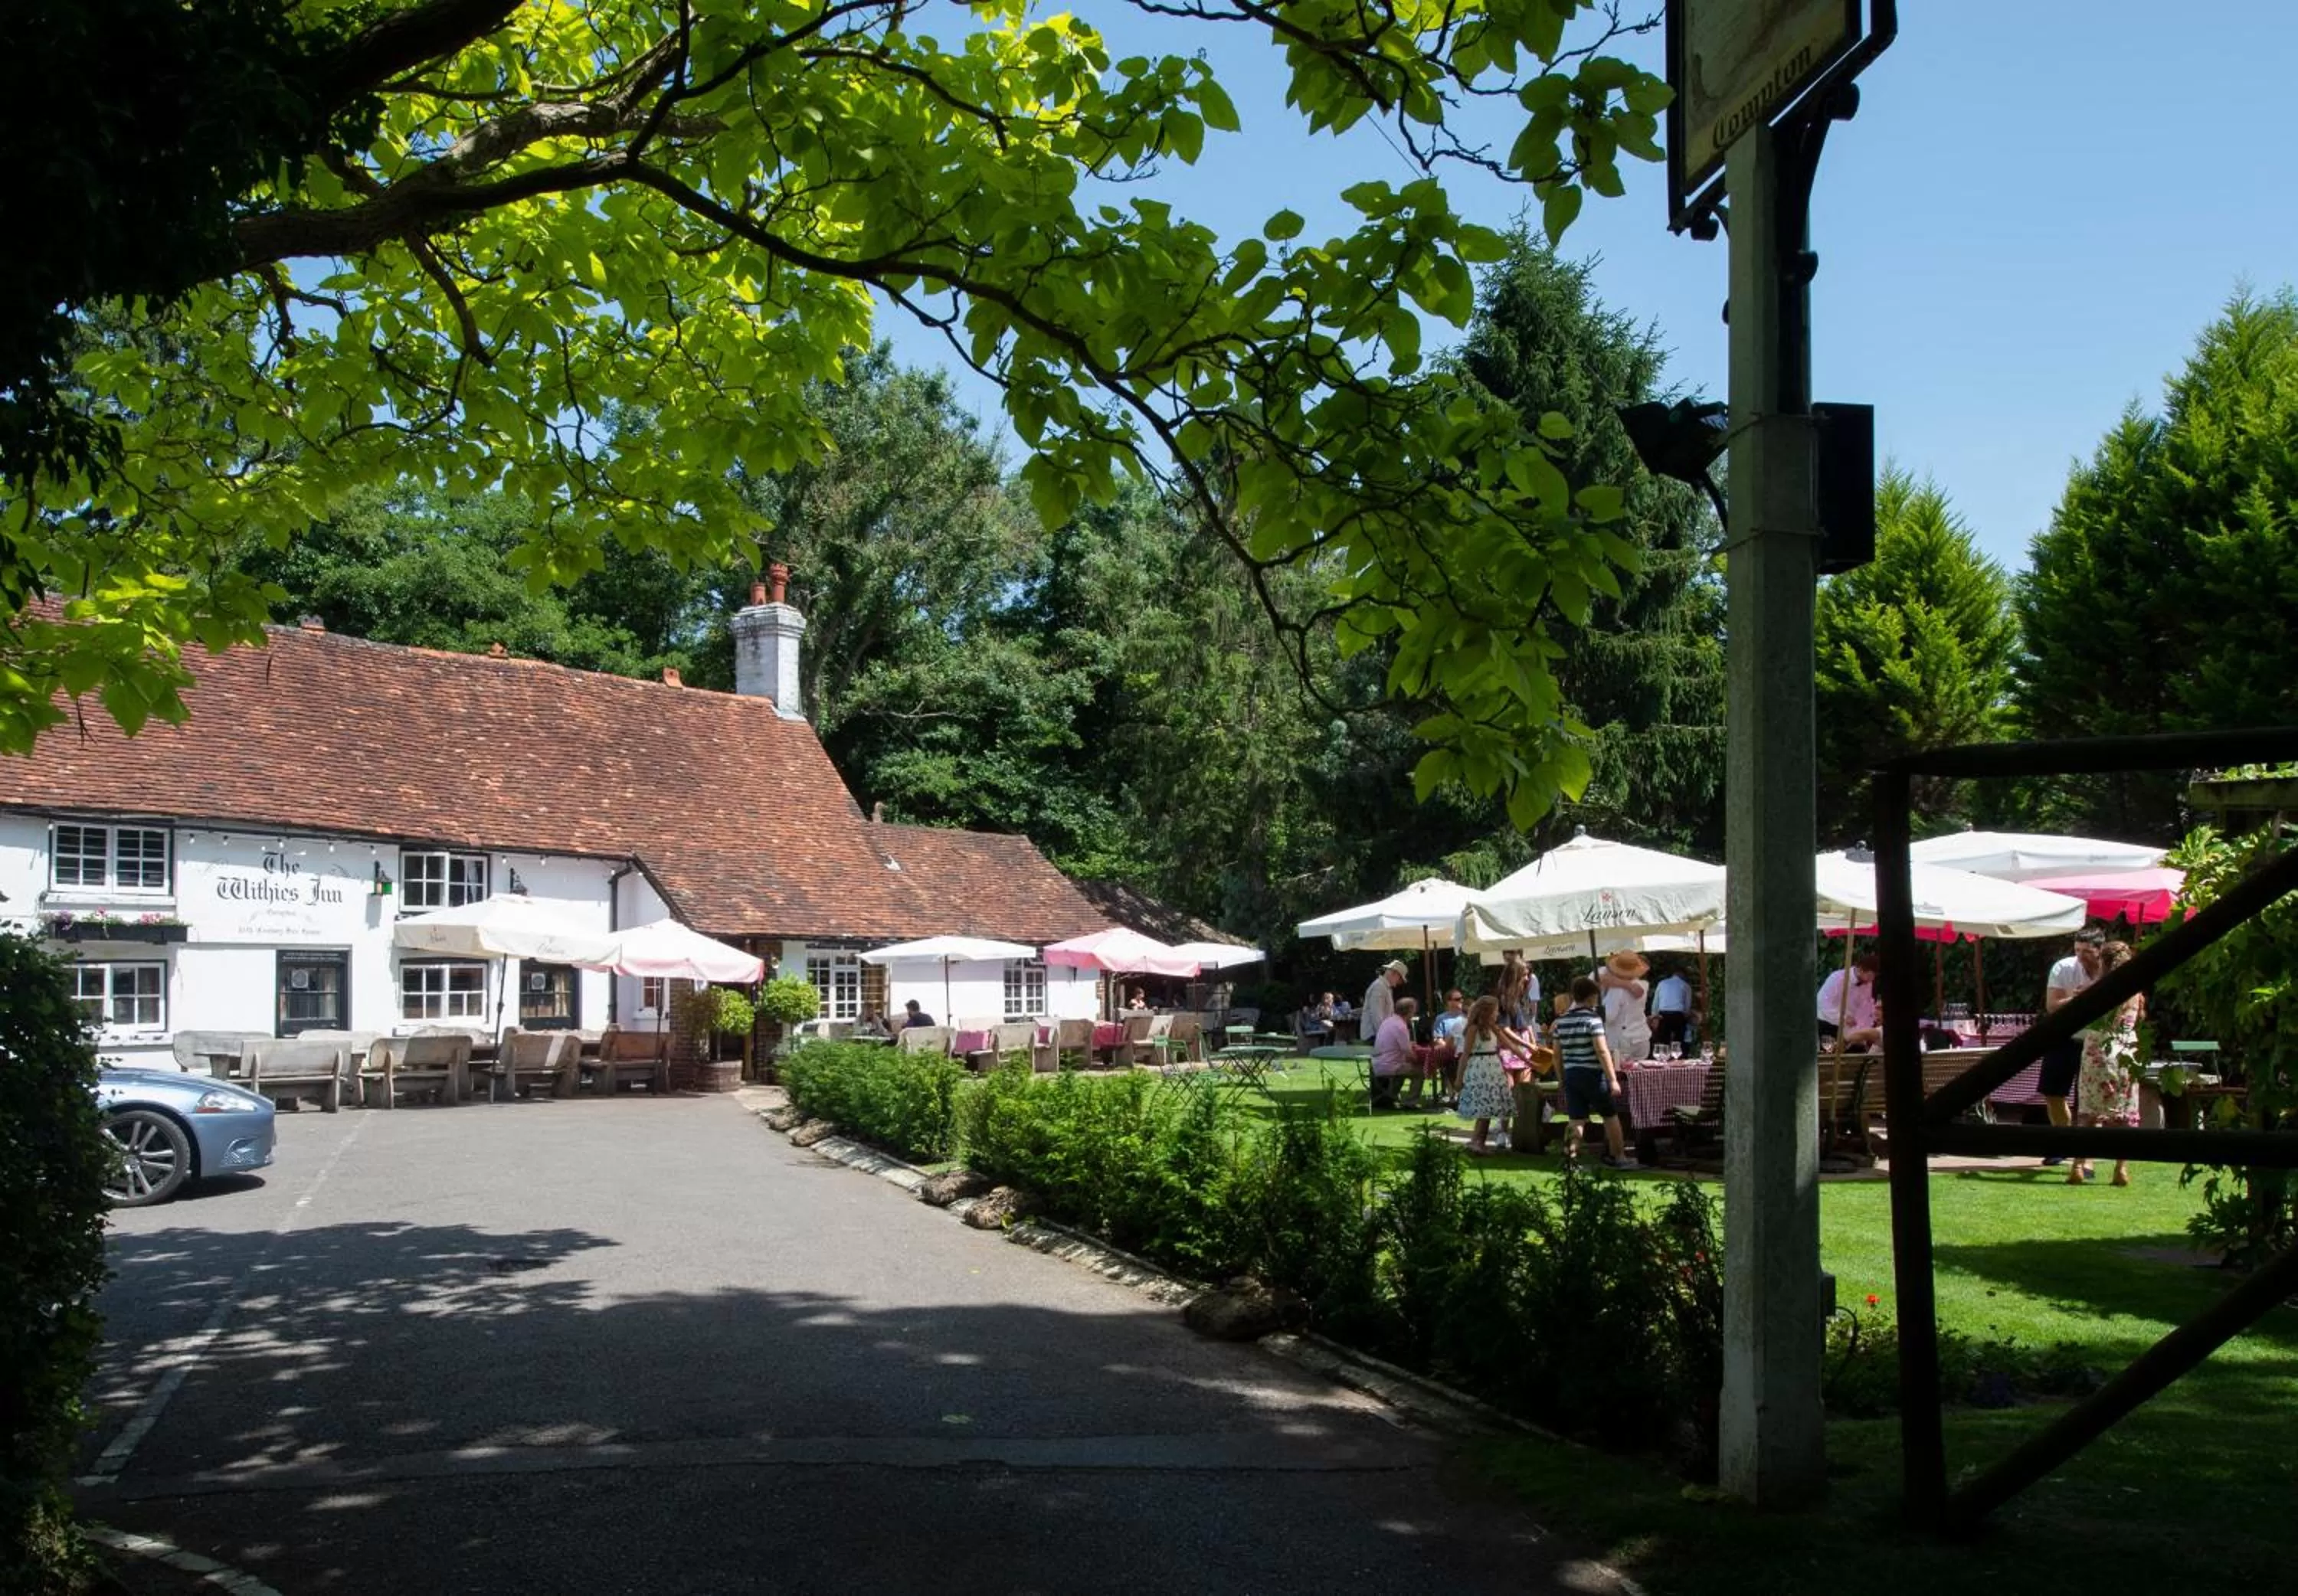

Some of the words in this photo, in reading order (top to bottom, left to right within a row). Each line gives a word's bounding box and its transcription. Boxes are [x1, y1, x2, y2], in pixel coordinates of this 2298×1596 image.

[1713, 45, 1811, 149] Compton
[263, 851, 300, 880] The
[217, 876, 300, 904] Withies
[306, 875, 342, 906] Inn
